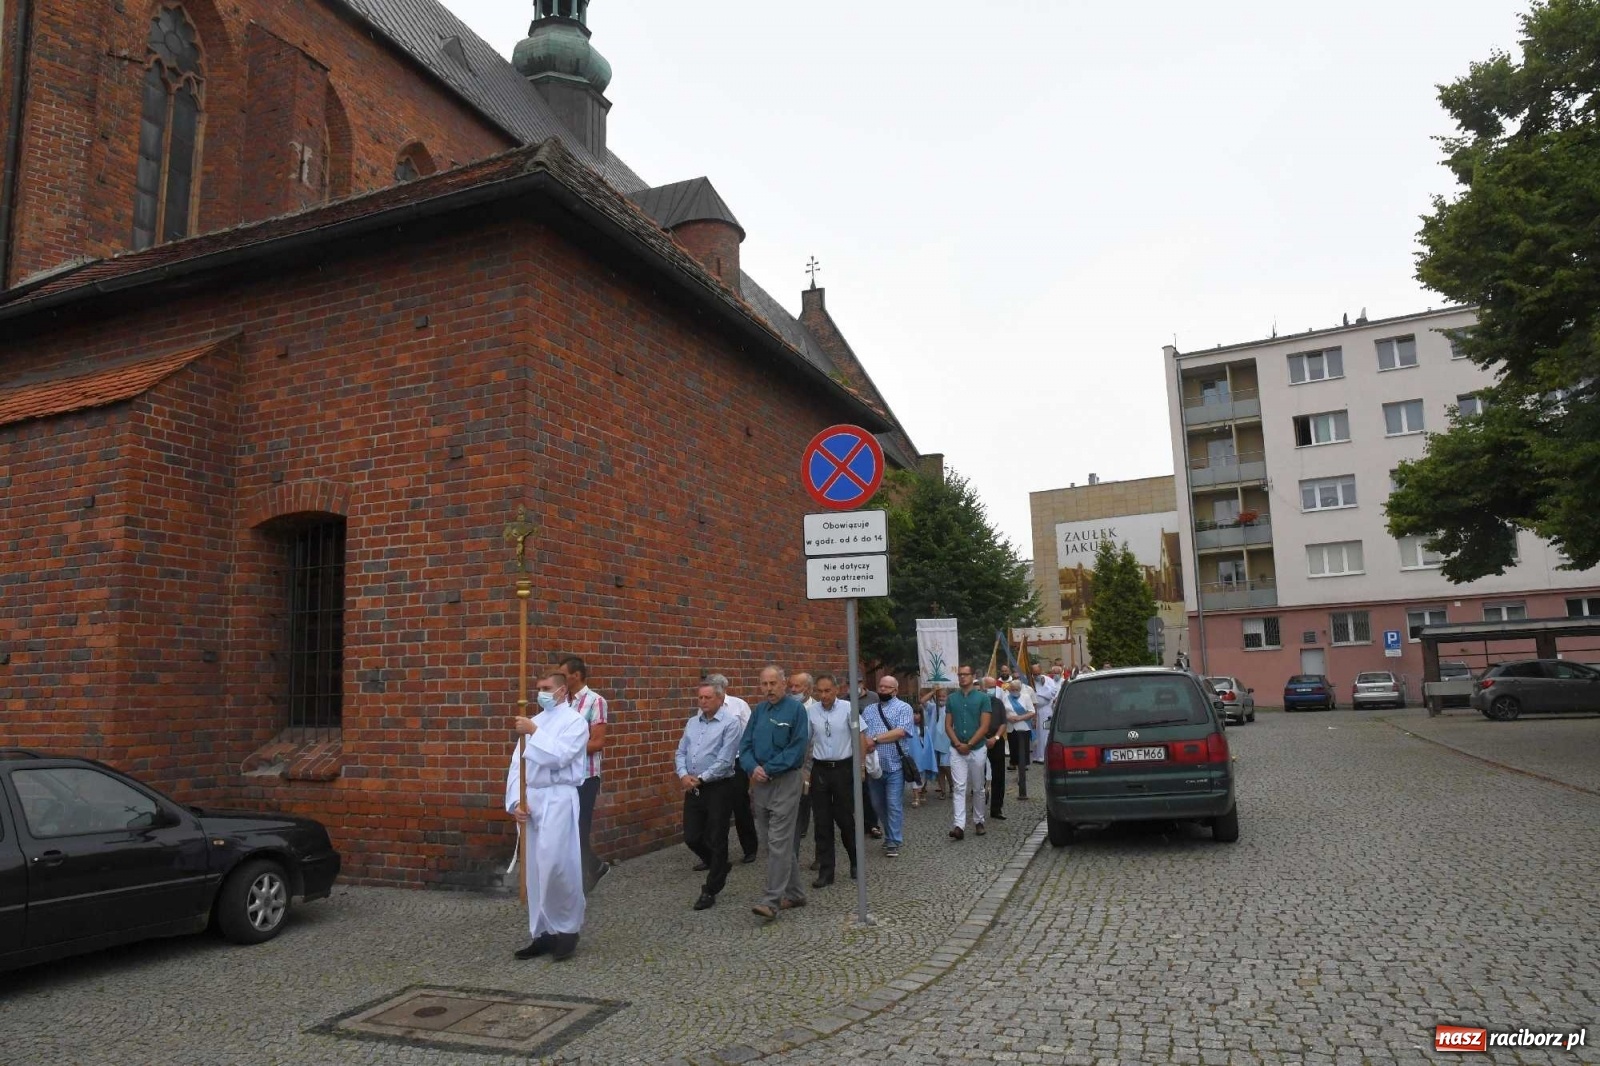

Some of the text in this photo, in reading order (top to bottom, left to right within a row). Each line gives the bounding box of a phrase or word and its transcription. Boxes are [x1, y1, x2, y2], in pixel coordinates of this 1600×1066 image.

[822, 521, 869, 530] Obowiązuje
[815, 538, 837, 546] godz.
[1065, 540, 1117, 556] JAKUA
[822, 573, 874, 582] zaopatrzenia
[1387, 632, 1397, 645] P
